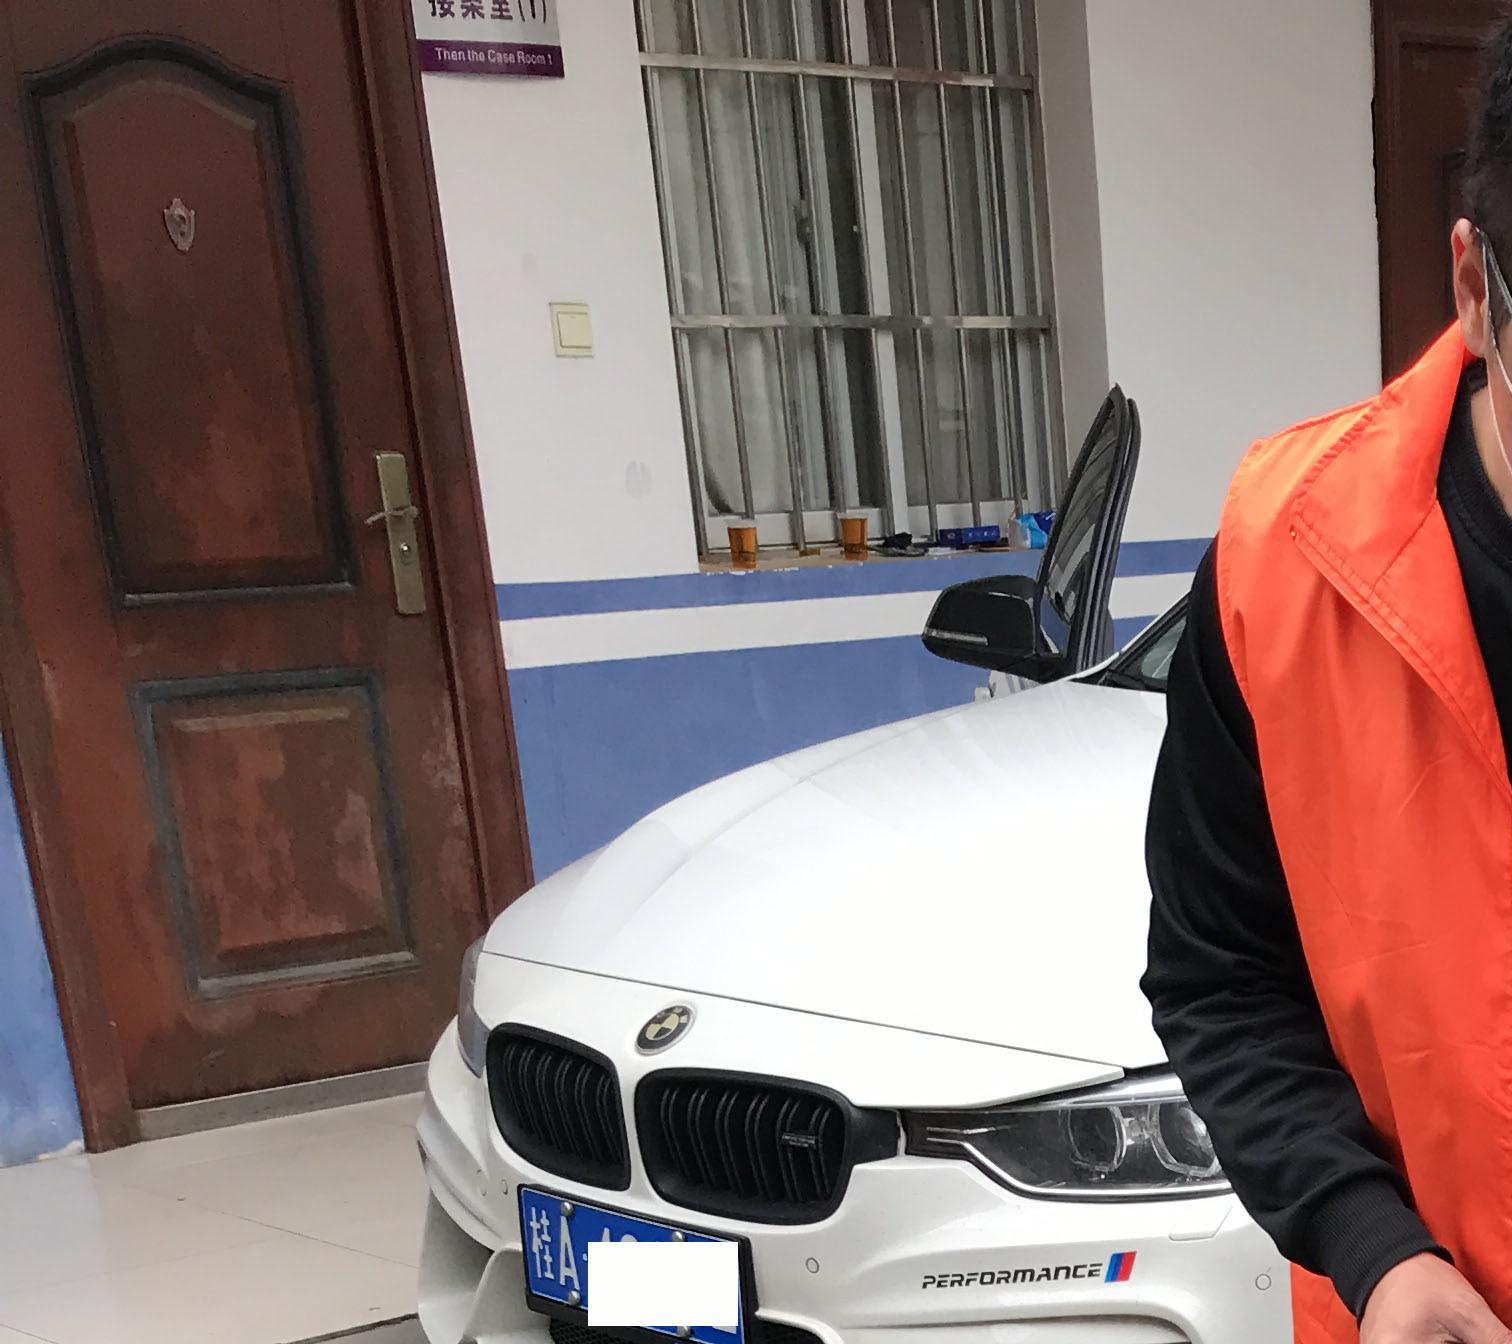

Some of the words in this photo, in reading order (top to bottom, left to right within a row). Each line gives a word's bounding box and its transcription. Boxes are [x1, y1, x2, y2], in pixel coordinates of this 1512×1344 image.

[435, 47, 465, 61] Then
[468, 49, 485, 62] the
[487, 49, 516, 64] Case
[517, 51, 546, 65] Room
[921, 1263, 1103, 1289] PERFORMANCE
